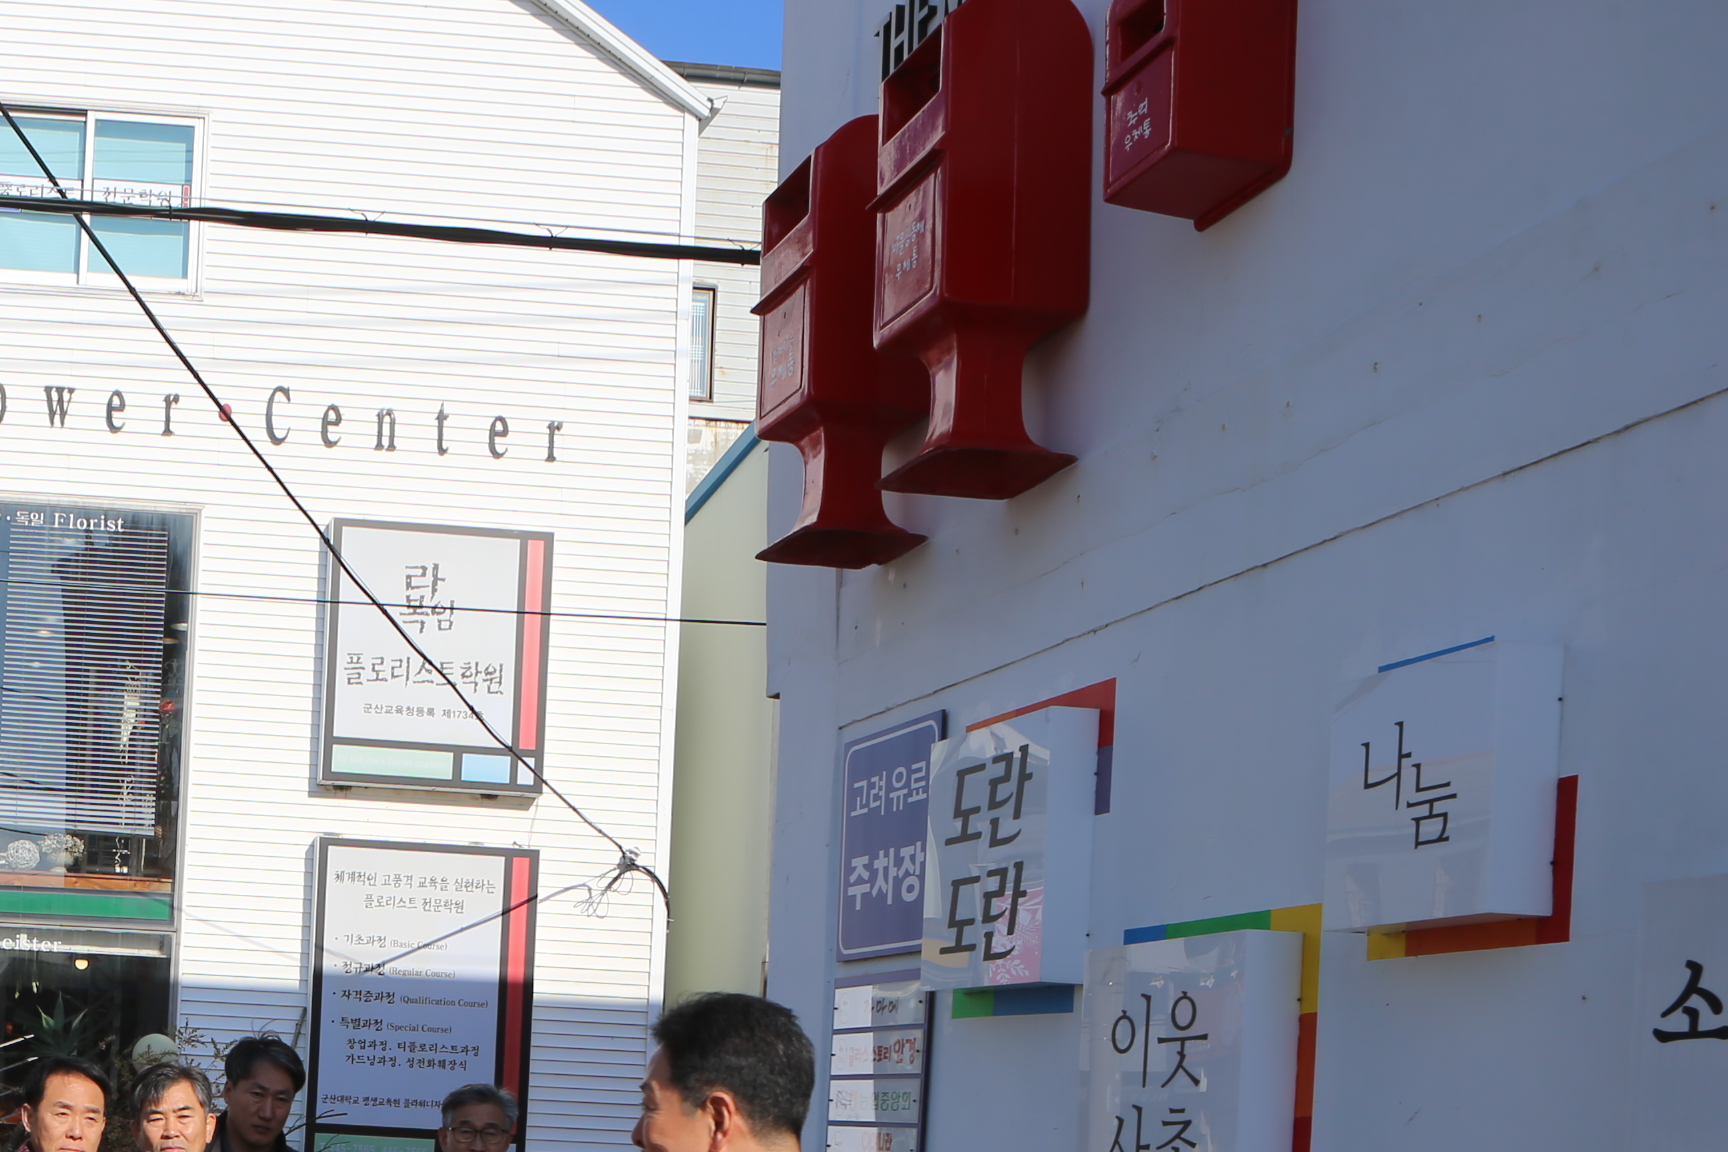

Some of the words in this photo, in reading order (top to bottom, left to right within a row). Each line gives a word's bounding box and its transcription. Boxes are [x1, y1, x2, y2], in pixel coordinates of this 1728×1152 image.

[1124, 118, 1151, 151] 우체통
[264, 386, 563, 463] Center
[16, 510, 44, 526] 독일
[54, 512, 125, 532] Florist
[362, 703, 436, 718] 군산교육청등록
[850, 770, 887, 817] 고려
[889, 761, 928, 812] 유료
[944, 743, 1034, 849] 도란
[1360, 720, 1458, 850] 나눔
[333, 870, 378, 888] 체계적인
[380, 873, 414, 889] 고품격
[417, 876, 449, 892] 교육을
[453, 877, 497, 895] 실현하는
[847, 841, 925, 911] 주차장
[363, 893, 418, 910] 플로리스트
[421, 897, 465, 914] 전문학원
[939, 860, 1028, 962] 도란
[343, 933, 387, 949] 기초과정
[389, 939, 415, 950] (Basic
[342, 961, 386, 976] 정규과정
[388, 967, 423, 978] (Regular
[425, 968, 456, 979] Course)
[340, 989, 396, 1005] 자격증과정
[399, 995, 456, 1007] (Qualification
[458, 997, 489, 1009] Course)
[339, 1016, 384, 1032] 특별과정
[386, 1022, 419, 1034] (Special
[421, 1023, 452, 1035] Course)
[893, 1037, 918, 1065] 안경
[1110, 990, 1210, 1089] 이웃
[403, 1098, 443, 1110] 플라워디자
